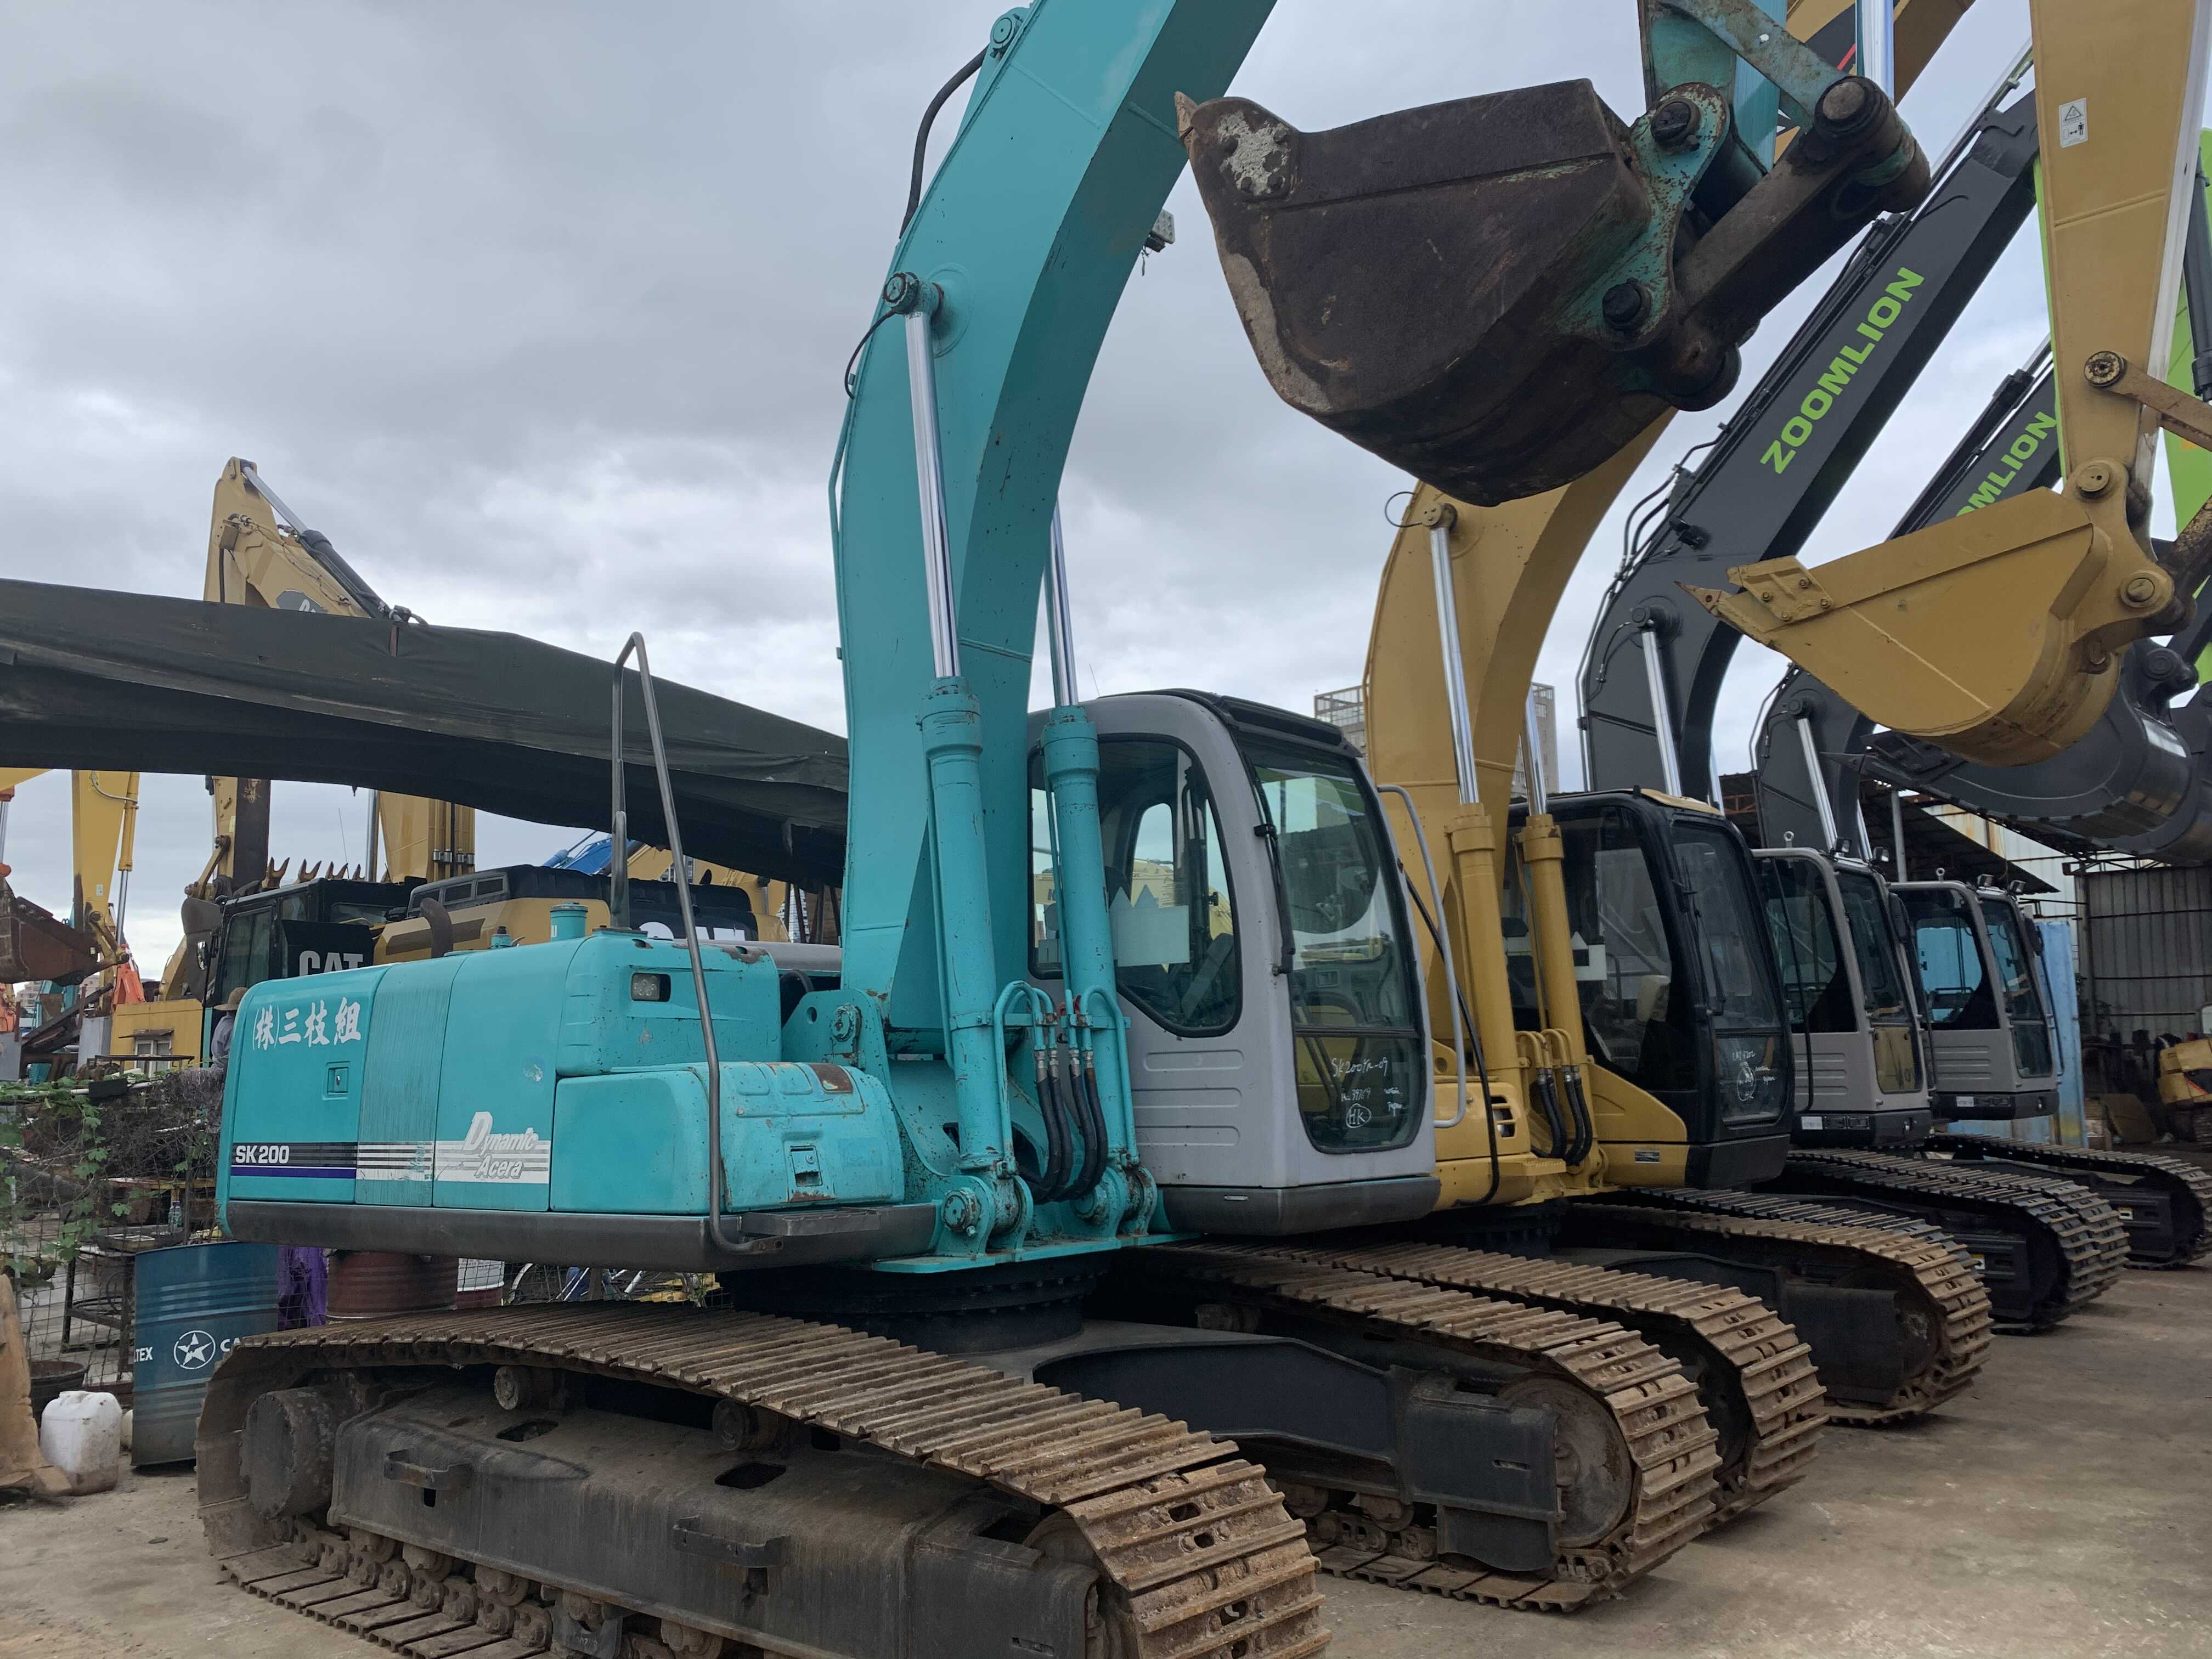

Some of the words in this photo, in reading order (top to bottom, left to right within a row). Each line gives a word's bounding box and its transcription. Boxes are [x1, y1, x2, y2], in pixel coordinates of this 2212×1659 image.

[1760, 267, 1924, 474] ZOOMLION
[464, 1111, 539, 1156] Dynamic
[235, 1146, 289, 1164] SK200
[475, 1154, 523, 1179] Acera
[133, 1347, 153, 1362] TEX
